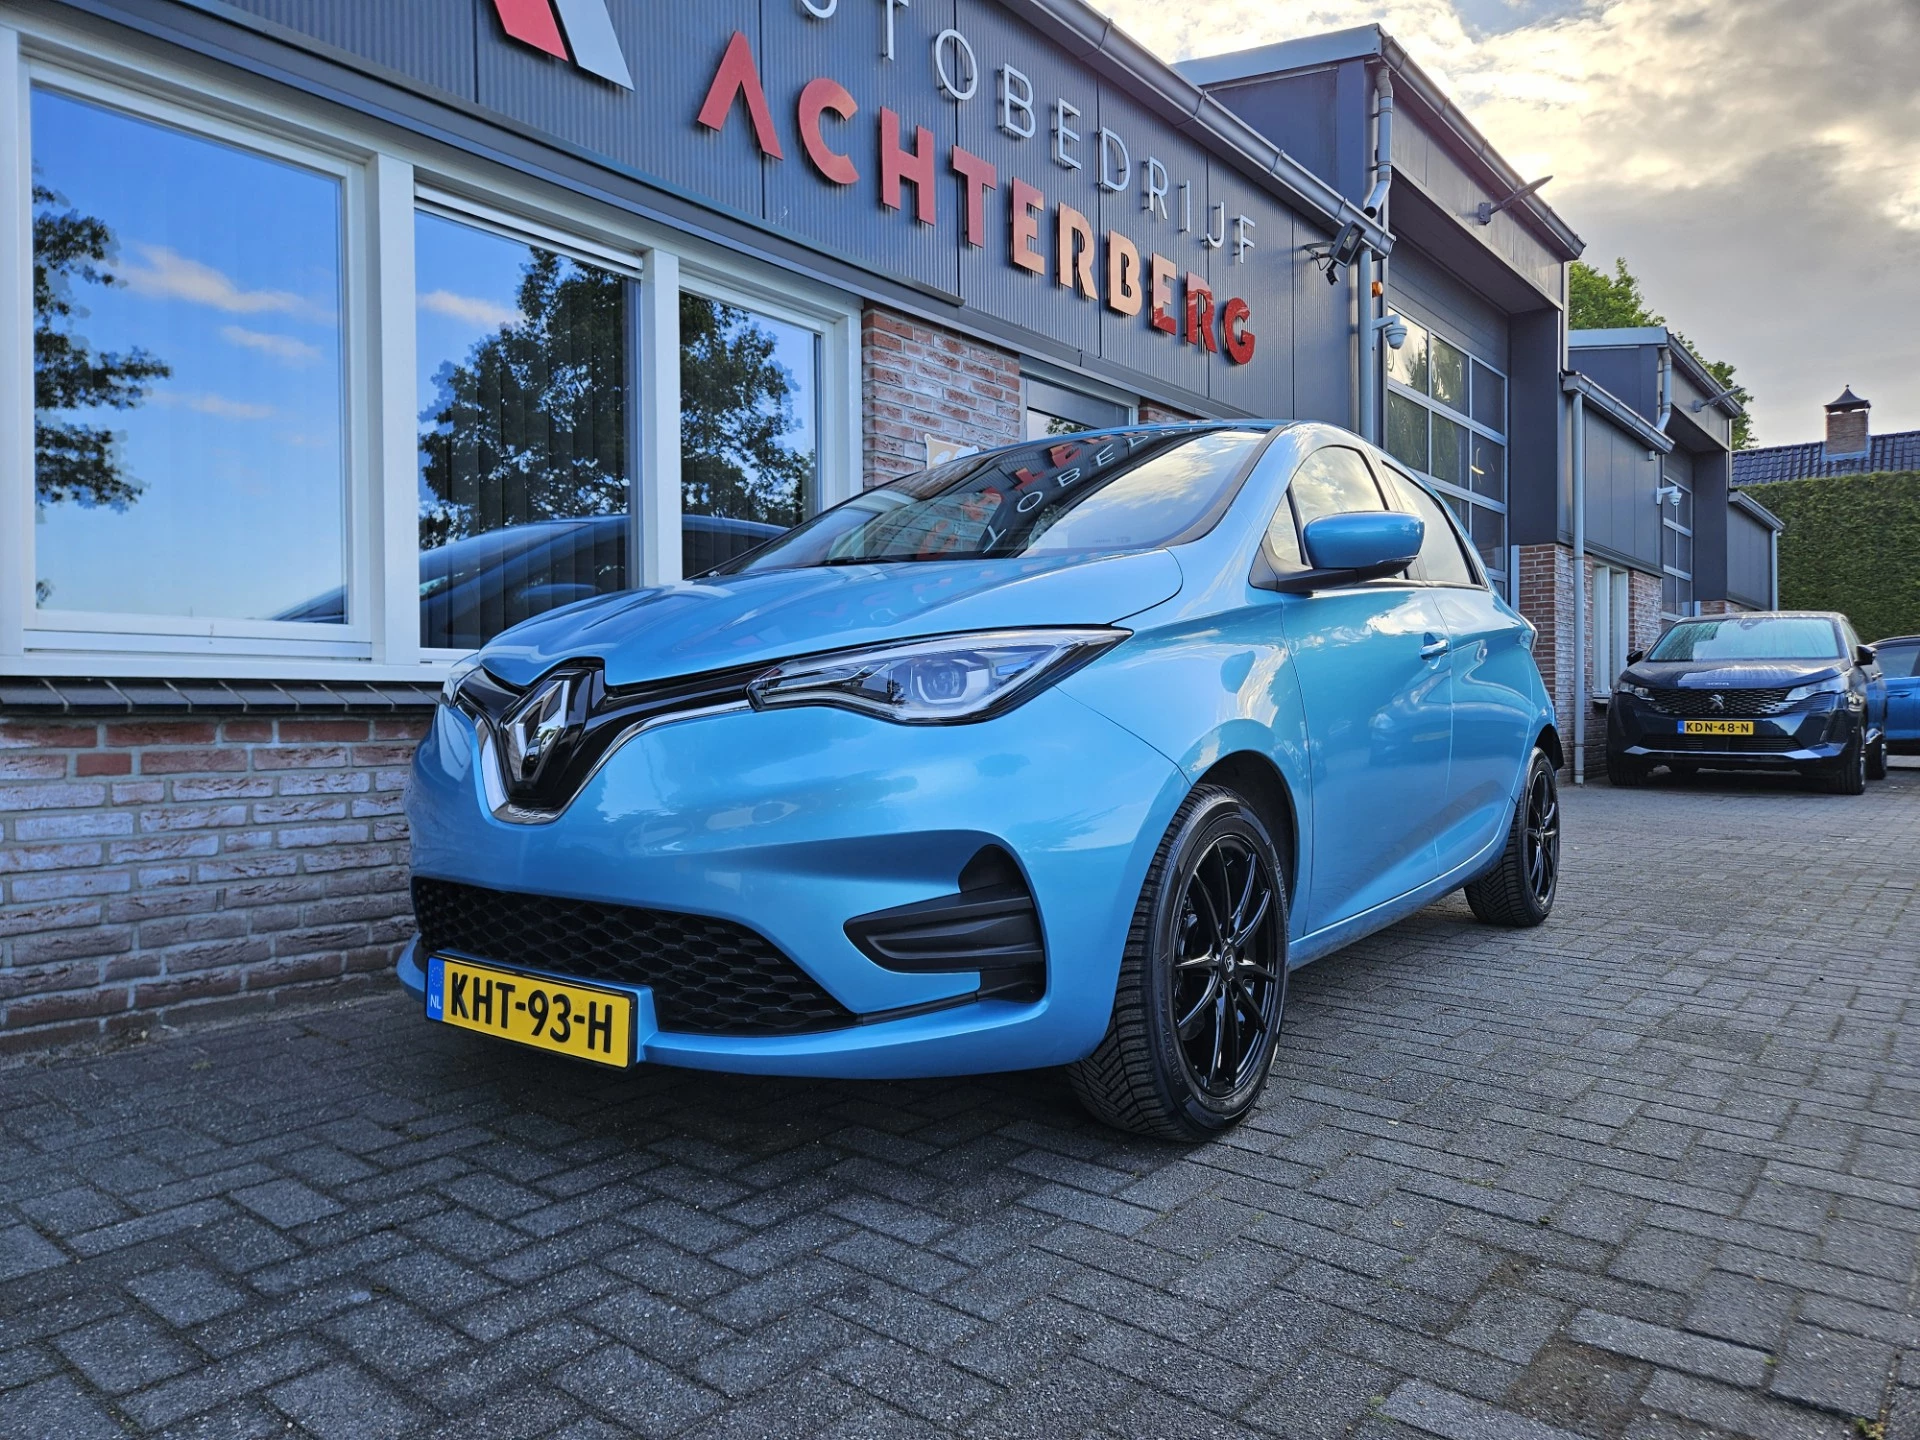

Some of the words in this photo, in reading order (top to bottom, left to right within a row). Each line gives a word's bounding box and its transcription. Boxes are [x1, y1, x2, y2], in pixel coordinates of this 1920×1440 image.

[801, 0, 1256, 264] TOBEDRIJF
[697, 30, 1256, 365] ACHTERBERG
[1686, 722, 1749, 733] KDN-48-N
[430, 994, 442, 1010] NL
[451, 971, 613, 1054] KHT-93-H
